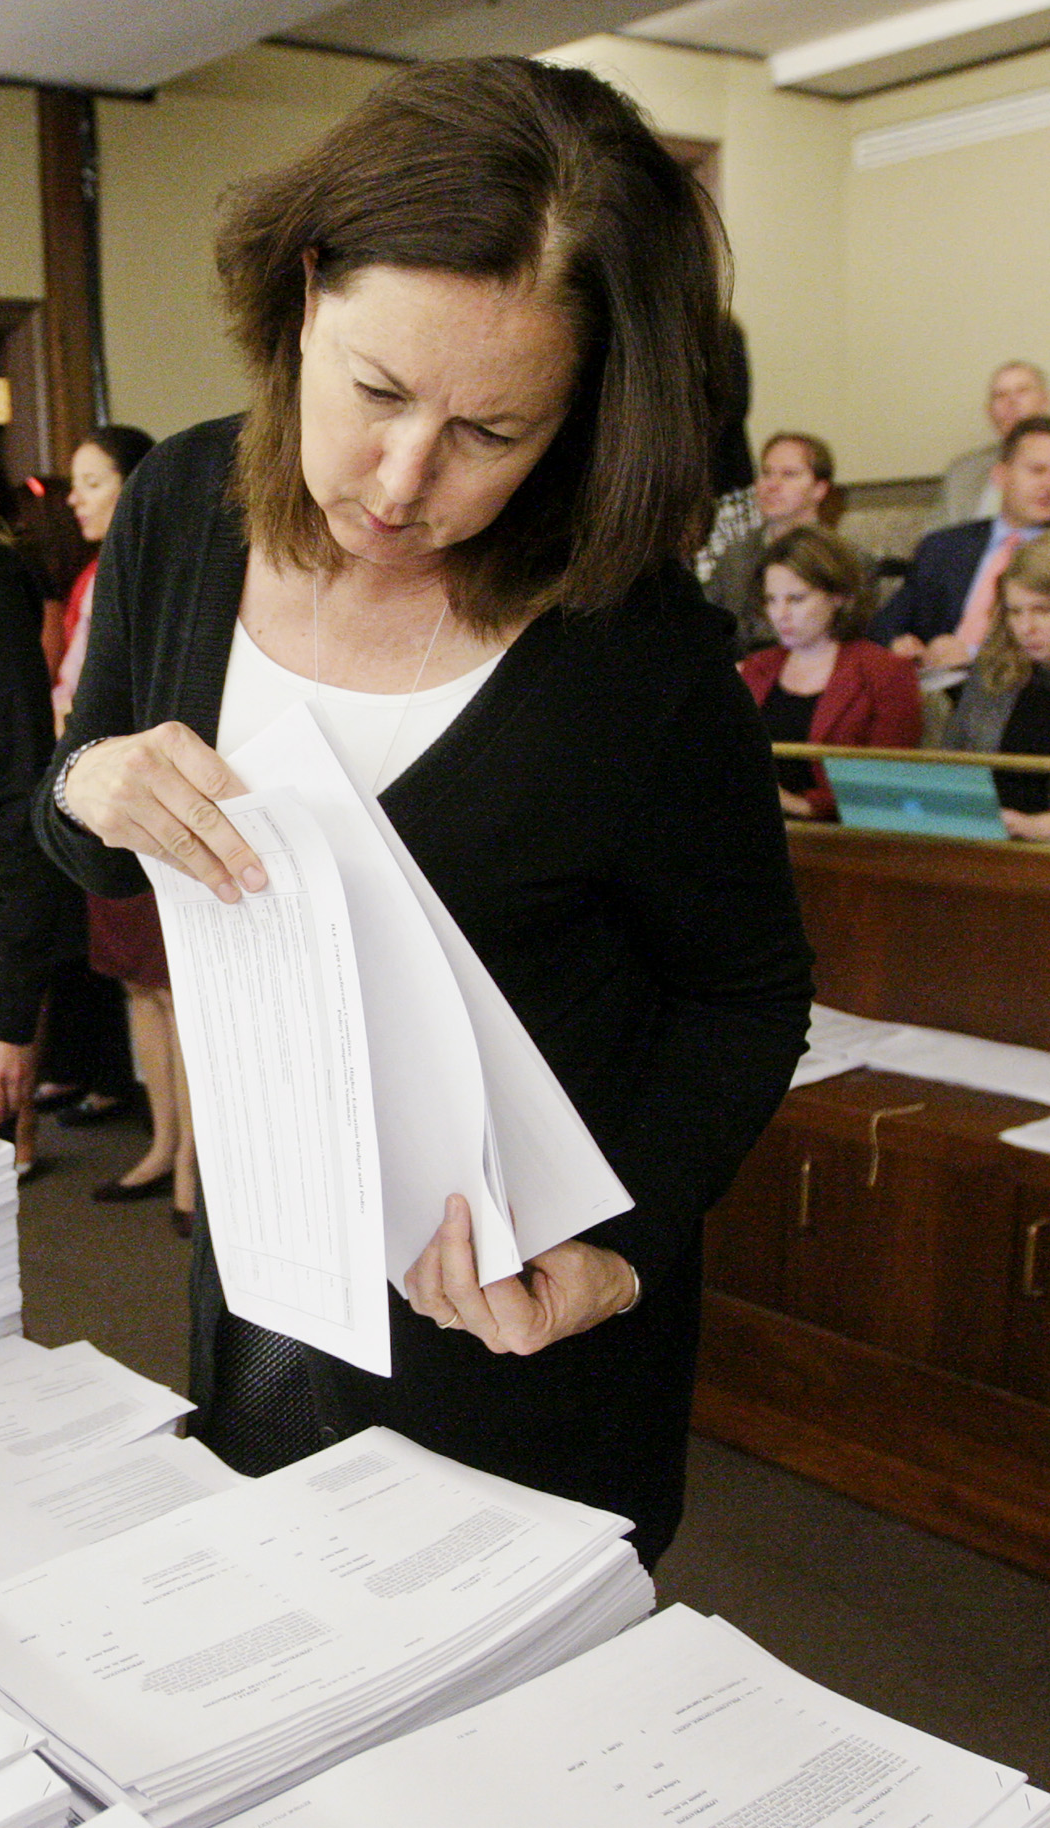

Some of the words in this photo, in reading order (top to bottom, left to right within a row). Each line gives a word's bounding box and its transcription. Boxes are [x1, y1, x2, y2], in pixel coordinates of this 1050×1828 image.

[336, 1009, 344, 1033] Policy
[340, 1035, 349, 1086] Comparison
[336, 964, 347, 1010] Conference
[343, 1012, 352, 1057] Committee
[351, 1097, 359, 1139] Education
[357, 1172, 365, 1188] and
